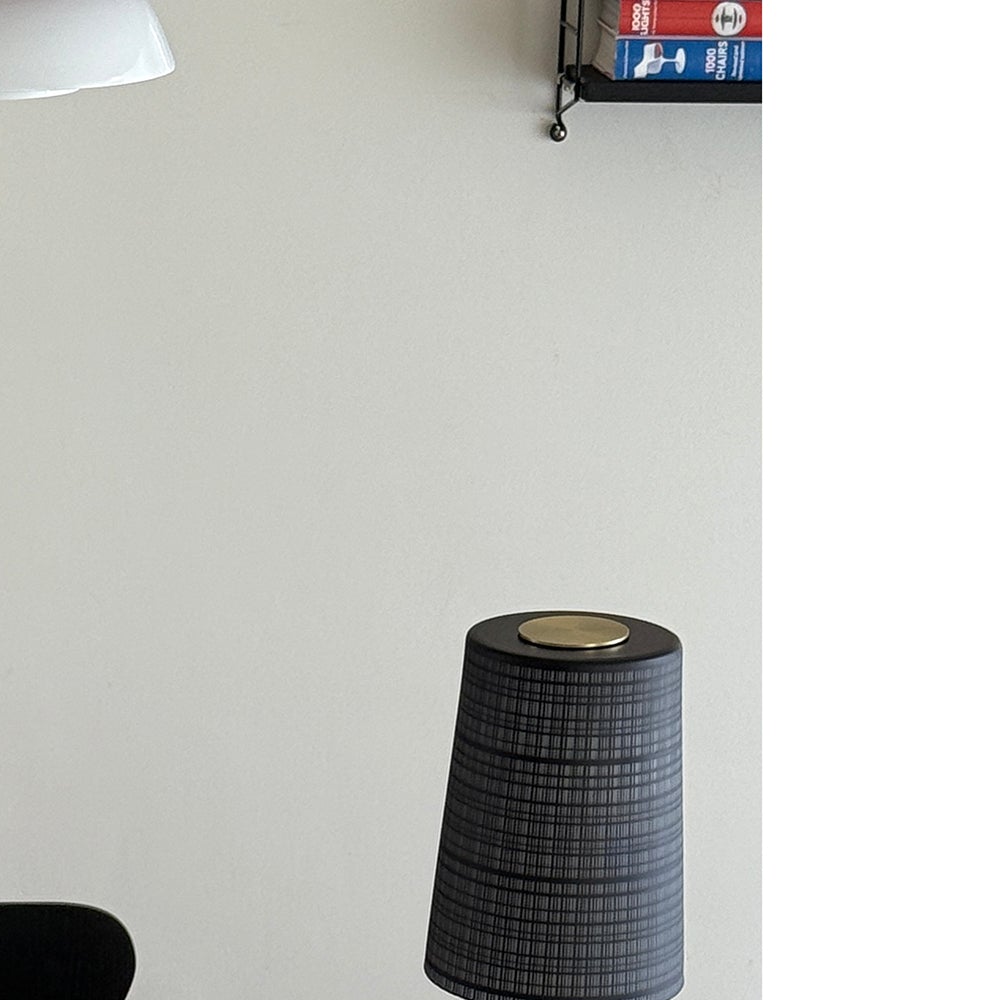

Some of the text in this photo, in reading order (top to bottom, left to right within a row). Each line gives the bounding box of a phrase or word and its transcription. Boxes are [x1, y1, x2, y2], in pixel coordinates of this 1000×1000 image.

[631, 3, 641, 31] 1000
[640, 0, 651, 36] LIGHTS
[705, 48, 716, 74] 1000
[715, 41, 728, 80] CHAIRS
